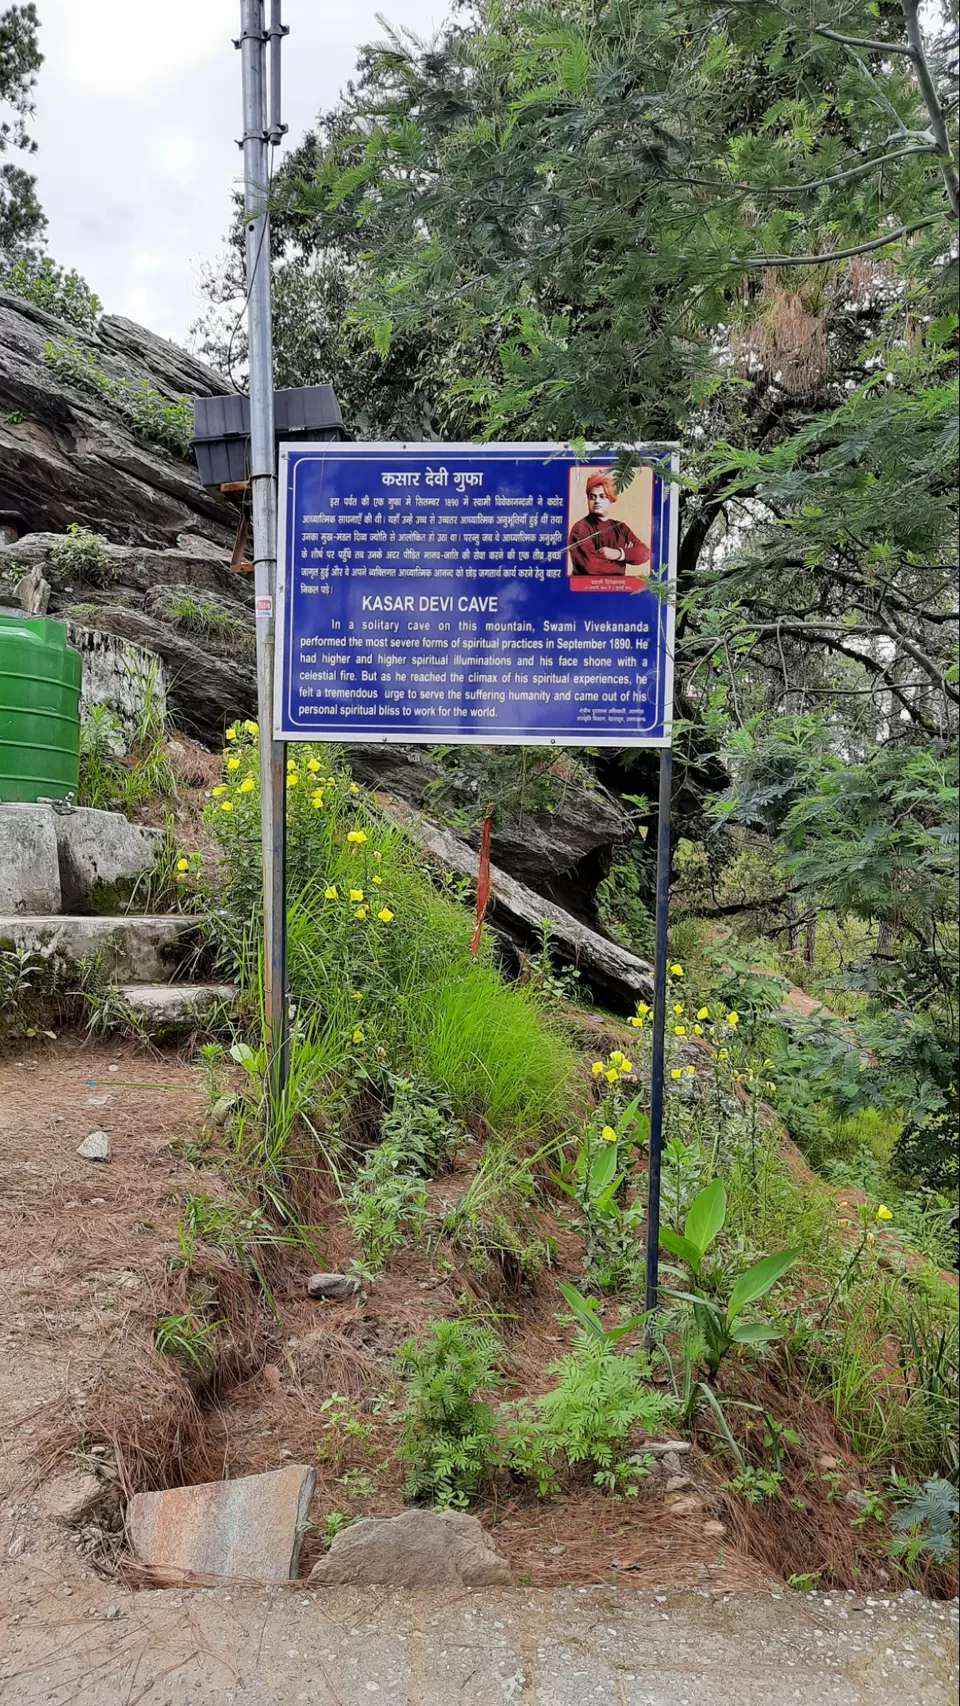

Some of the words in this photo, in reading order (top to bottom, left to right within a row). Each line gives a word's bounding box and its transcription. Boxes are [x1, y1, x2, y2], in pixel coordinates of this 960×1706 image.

[381, 473, 421, 486] कसार
[425, 467, 449, 487] देवी
[453, 472, 484, 492] गुफा
[363, 596, 414, 611] KASAR
[420, 597, 453, 611] DEVI
[458, 597, 498, 612] CAVE
[332, 619, 341, 629] In
[362, 620, 399, 633] solitary
[408, 622, 430, 630] cave
[439, 623, 450, 631] on
[459, 621, 477, 631] this
[486, 621, 535, 633] mountain,
[544, 620, 576, 632] Swami
[584, 621, 649, 632] Vivekananda
[300, 636, 346, 649] performed
[349, 637, 363, 647] the
[366, 638, 388, 647] most
[390, 639, 420, 648] severe
[422, 638, 448, 648] forms
[452, 638, 460, 648] of
[463, 638, 499, 650] spiritual
[502, 638, 543, 650] practices
[546, 638, 554, 649] in
[557, 638, 607, 651] September
[610, 638, 633, 649] 1890.
[636, 639, 649, 650] He
[300, 652, 316, 663] had
[322, 653, 351, 666] higher
[356, 654, 372, 664] and
[378, 654, 407, 667] higher
[412, 655, 448, 667] spiritual
[454, 655, 512, 666] illuminations
[517, 656, 534, 666] and
[540, 656, 553, 666] his
[559, 656, 578, 666] face
[584, 656, 612, 667] shone
[618, 656, 637, 667] with
[642, 658, 648, 667] a
[300, 670, 336, 680] celestial
[340, 670, 357, 681] fire.
[362, 670, 377, 681] But
[381, 673, 391, 681] as
[396, 672, 406, 681] he
[411, 672, 446, 682] reached
[450, 672, 464, 682] the
[468, 672, 497, 683] climax
[502, 672, 511, 683] of
[515, 673, 528, 683] his
[533, 673, 570, 685] spiritual
[574, 674, 632, 686] experiences,
[636, 674, 648, 686] he
[300, 686, 313, 697] felt
[325, 688, 378, 698] tremendous
[385, 691, 405, 701] urge
[408, 689, 417, 699] to
[420, 691, 444, 699] serve
[448, 690, 462, 699] the
[465, 689, 505, 702] suffering
[509, 690, 551, 703] humanity
[554, 691, 571, 701] and
[574, 693, 599, 701] came
[602, 692, 617, 701] out
[620, 690, 630, 702] of
[633, 688, 647, 702] his
[299, 704, 338, 717] personal
[340, 704, 376, 717] spiritual
[379, 705, 400, 716] bliss
[403, 706, 412, 716] to
[414, 707, 436, 716] work
[438, 706, 451, 716] for
[454, 707, 468, 717] the
[470, 707, 497, 717] world.
